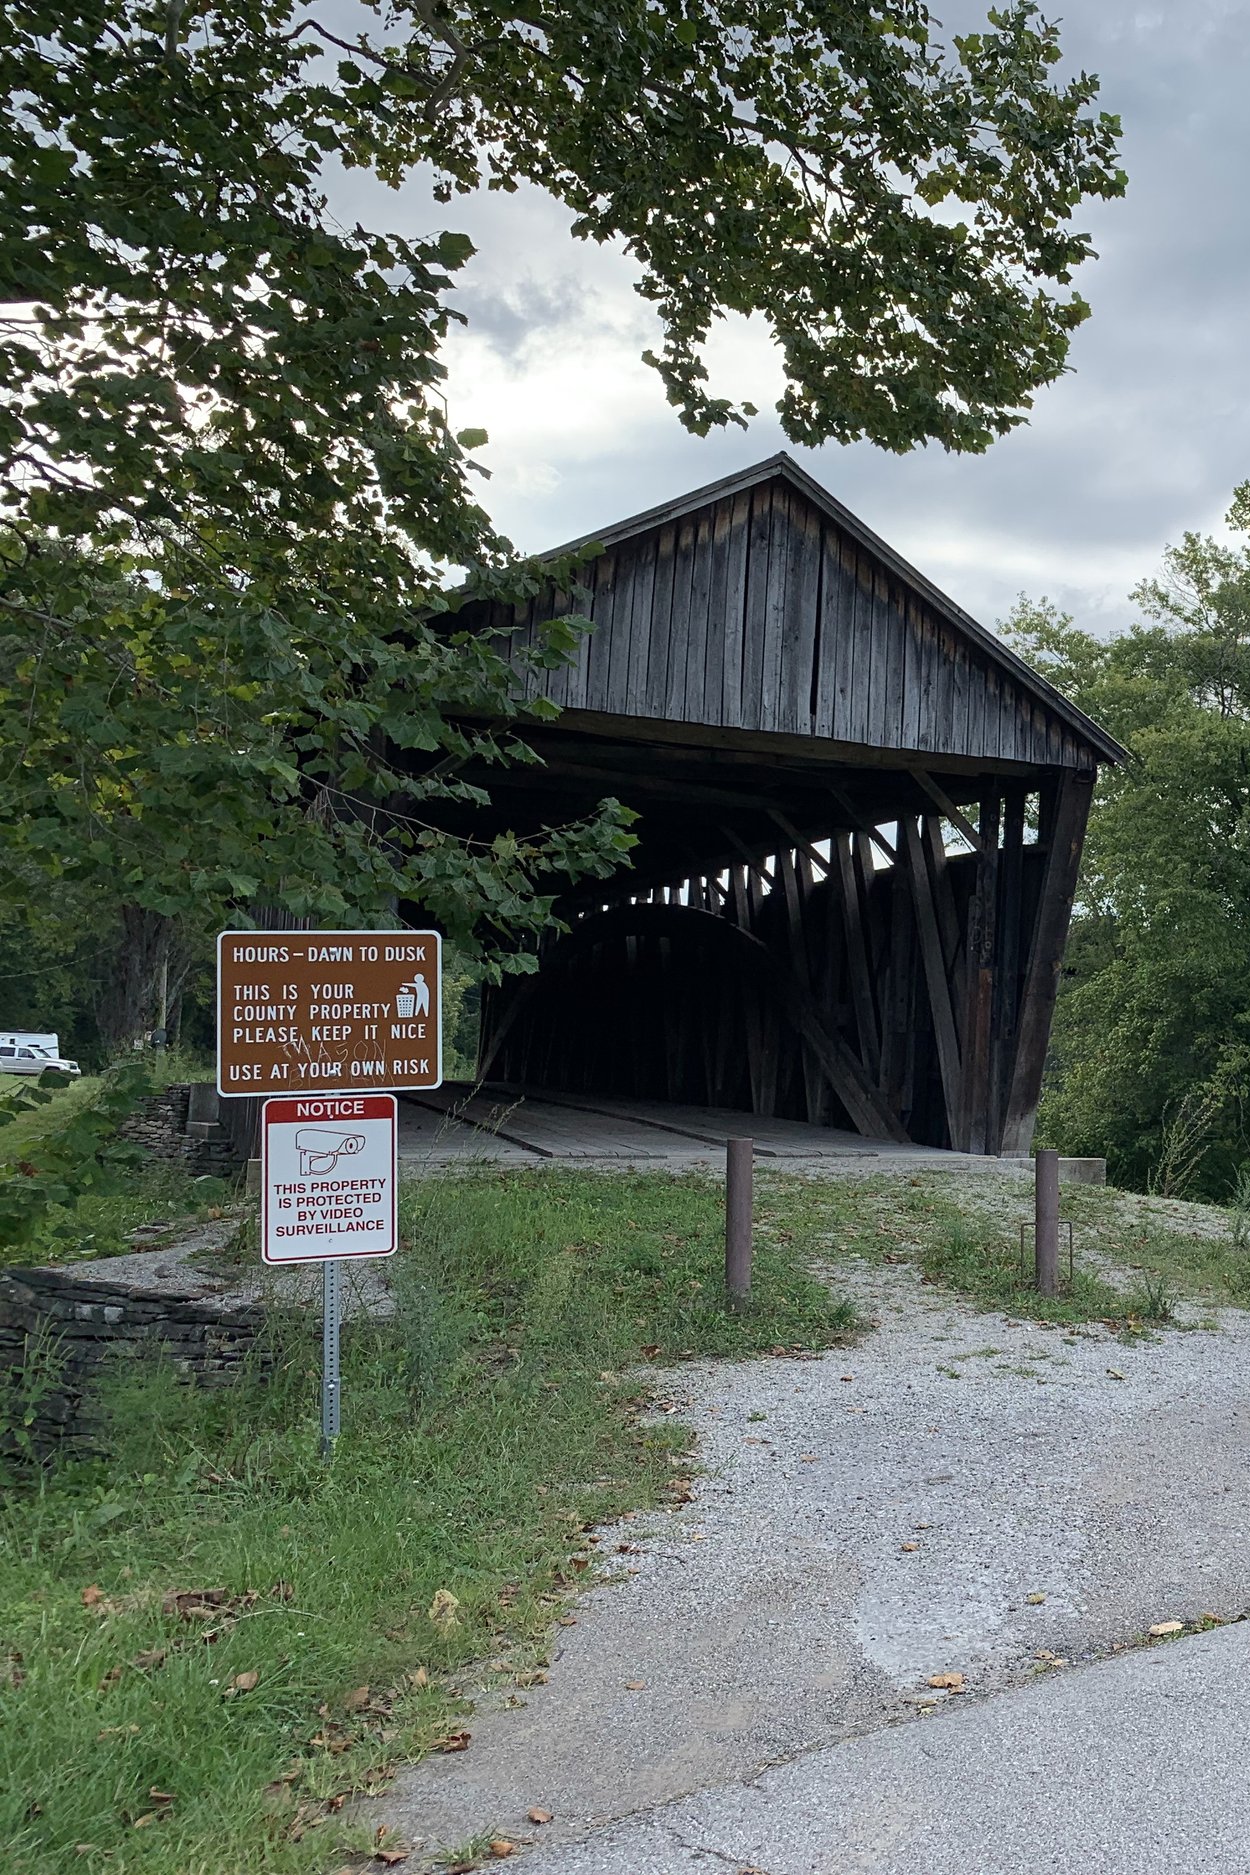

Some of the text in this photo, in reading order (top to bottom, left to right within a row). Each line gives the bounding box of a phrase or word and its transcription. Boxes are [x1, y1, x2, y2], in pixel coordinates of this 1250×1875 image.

[233, 947, 290, 963] HOURS
[308, 947, 353, 962] DAWN
[359, 946, 378, 961] TO
[384, 946, 426, 961] DUSK
[233, 983, 354, 1001] THIS IS YOUR
[232, 1003, 391, 1022] COUNTY PROPERTY
[233, 1023, 427, 1044] PLEASE KEEP IT NICE
[229, 1065, 262, 1081] USE
[270, 1063, 289, 1079] AT
[297, 1062, 342, 1078] YOUR
[351, 1060, 385, 1076] OWN
[393, 1059, 430, 1075] RISK
[296, 1100, 365, 1117] NOTICE
[273, 1178, 387, 1195] THIS PROPERTY
[278, 1192, 382, 1209] IS PROTECTED
[297, 1207, 363, 1222] BY VIDEO
[275, 1219, 385, 1237] SURVEILLANCE
